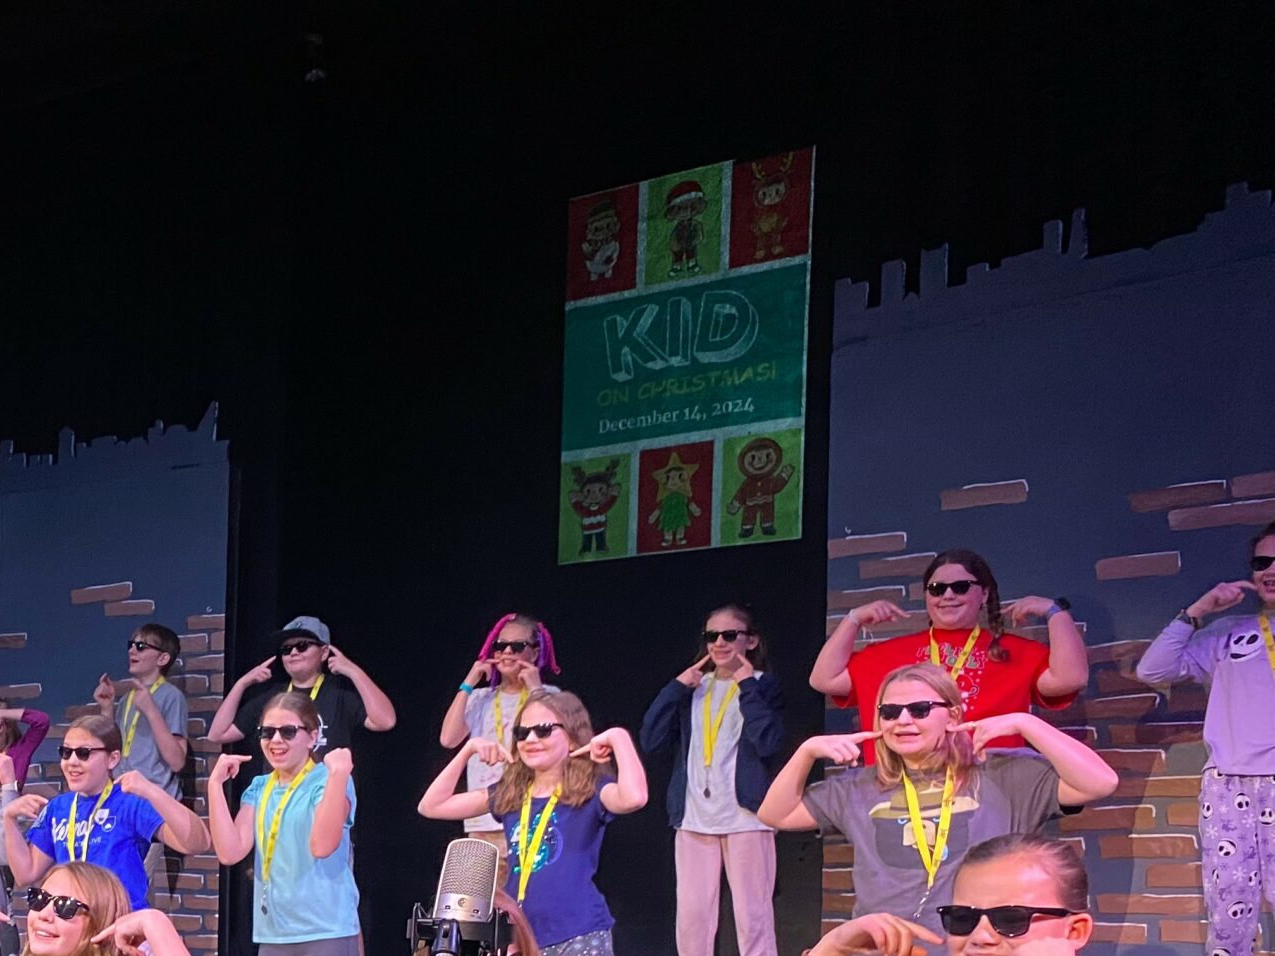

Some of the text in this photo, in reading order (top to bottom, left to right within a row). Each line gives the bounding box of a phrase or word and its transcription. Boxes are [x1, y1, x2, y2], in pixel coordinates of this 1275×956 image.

[604, 290, 759, 382] KID
[597, 385, 629, 407] ON
[598, 398, 755, 434] December 14, 2024
